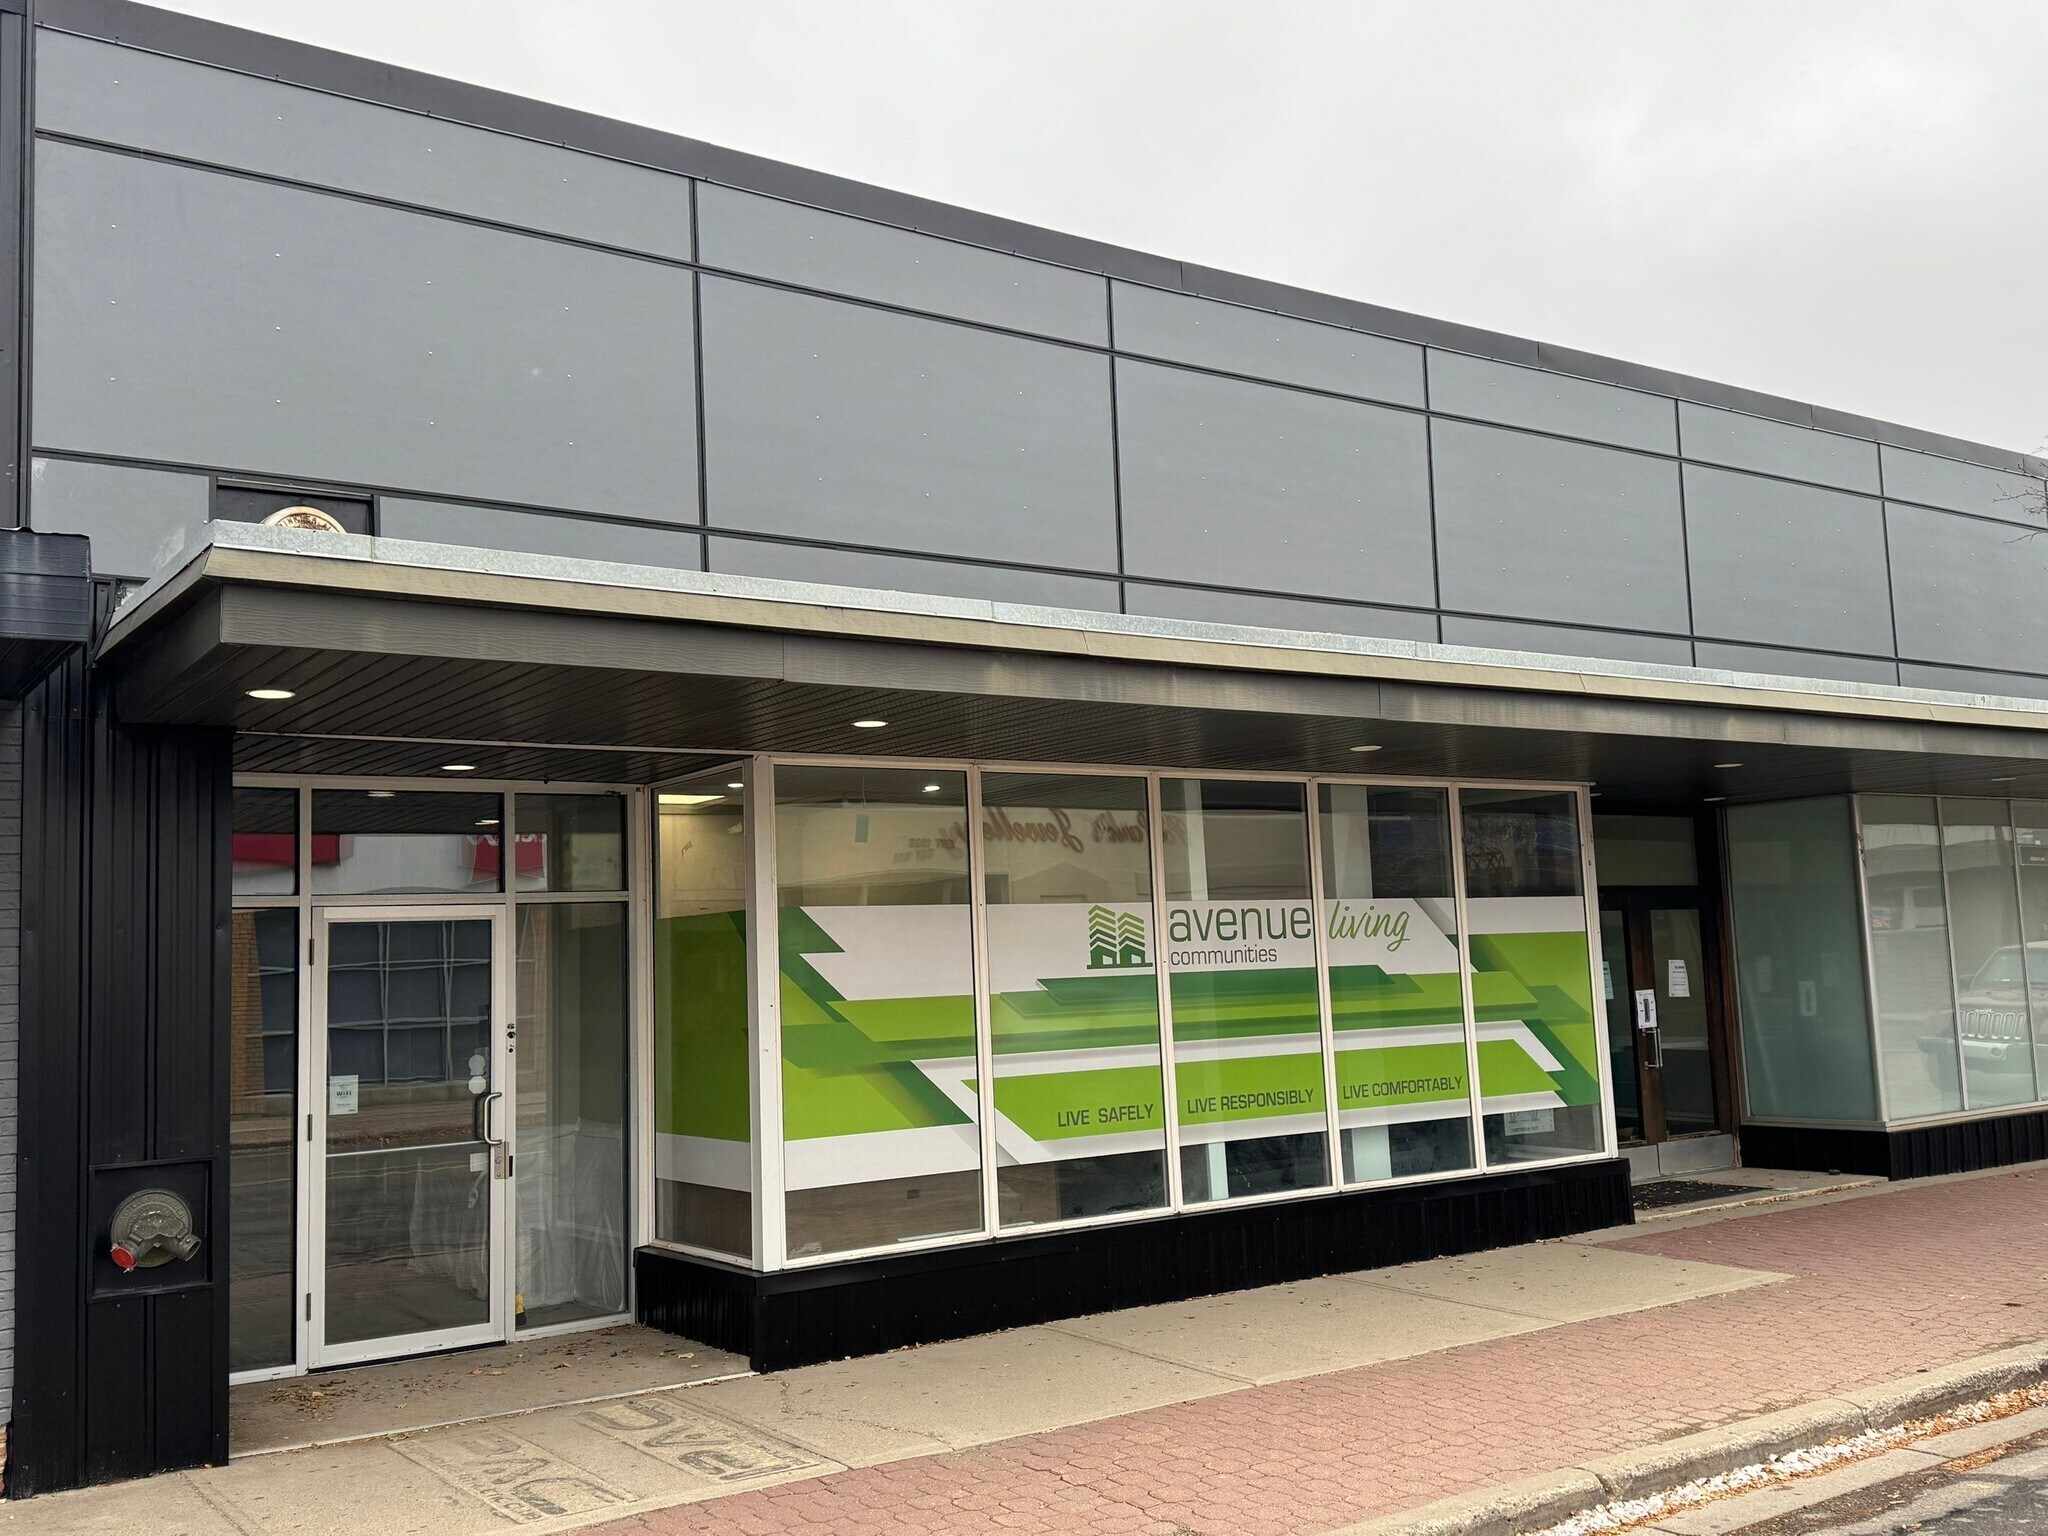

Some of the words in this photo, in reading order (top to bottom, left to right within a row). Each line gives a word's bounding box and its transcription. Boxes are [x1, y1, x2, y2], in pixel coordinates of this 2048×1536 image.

[1169, 906, 1311, 942] avenue
[1328, 900, 1410, 952] living
[1170, 944, 1278, 966] communities
[1342, 1083, 1369, 1099] LIVE
[1372, 1076, 1462, 1097] COMFORTABLY
[1187, 1097, 1217, 1114] LIVE
[1220, 1088, 1314, 1111] RESPONSIBLY
[1058, 1109, 1090, 1127] LIVE
[1098, 1103, 1154, 1124] SAFELY
